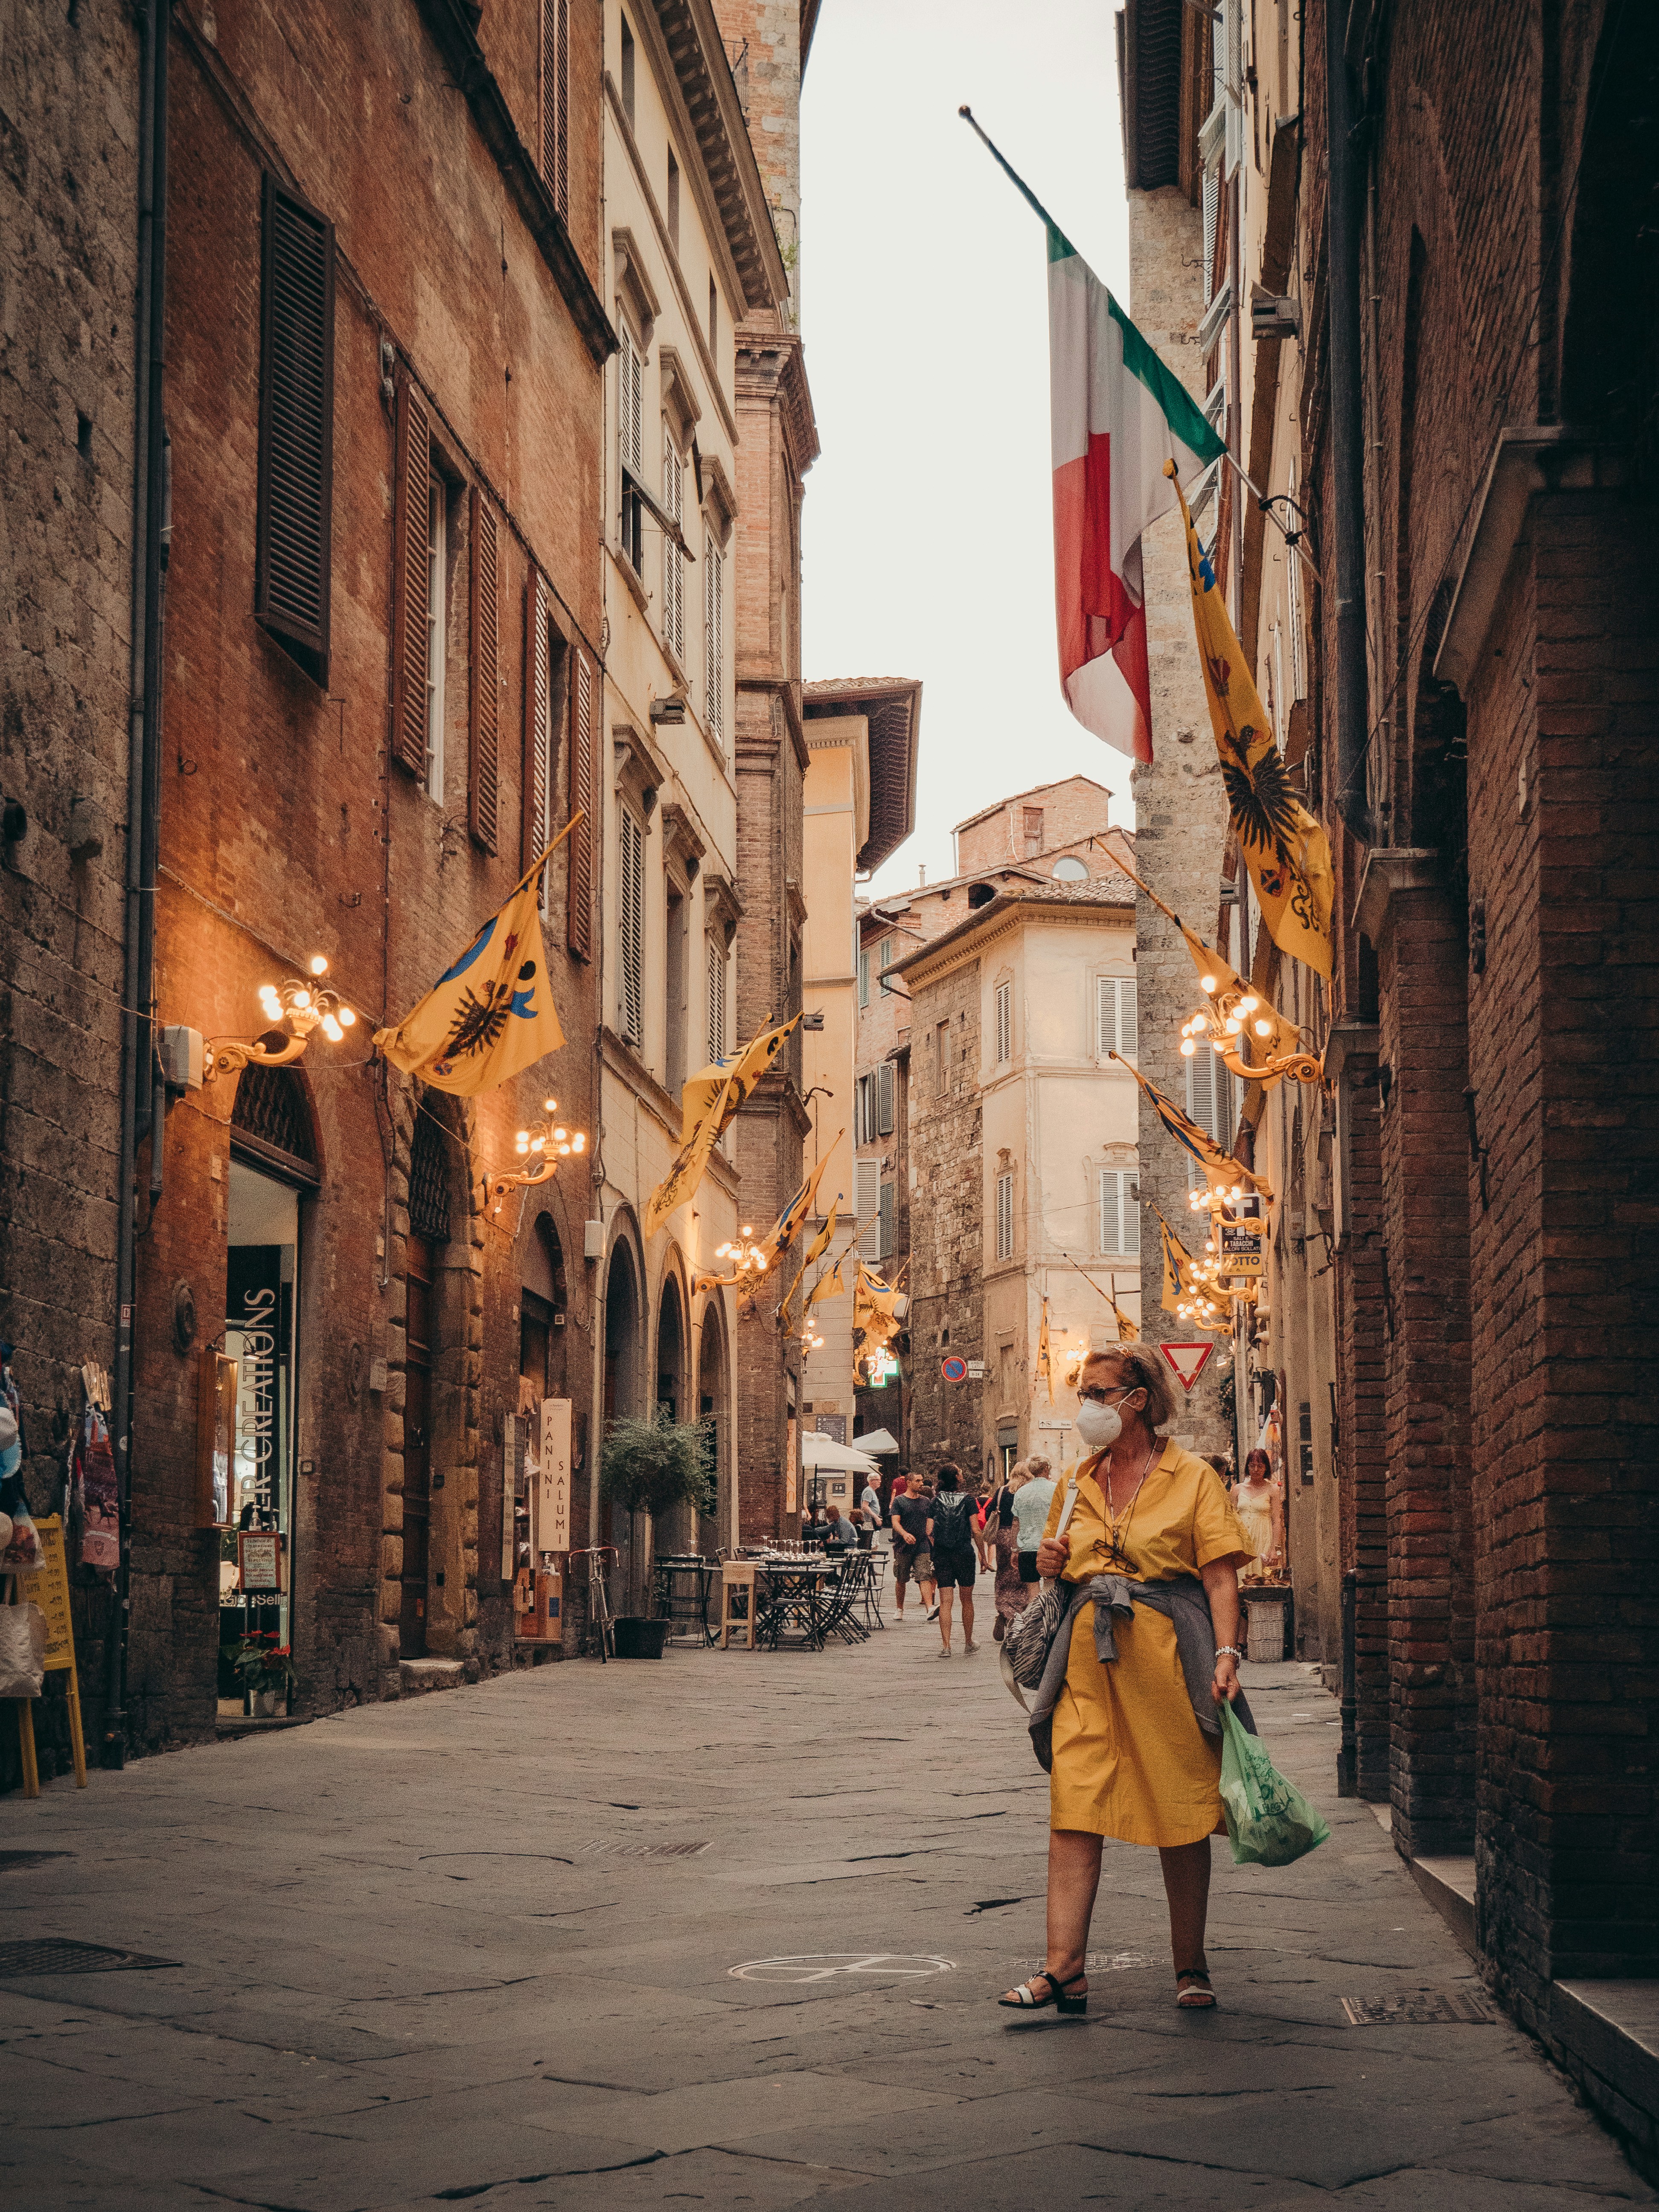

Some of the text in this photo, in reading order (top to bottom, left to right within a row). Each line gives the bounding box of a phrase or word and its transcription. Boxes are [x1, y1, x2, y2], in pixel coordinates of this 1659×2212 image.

[241, 1289, 275, 1463] CREATIONS
[544, 1416, 553, 1499] PANINI
[556, 1461, 565, 1544] SALUMI
